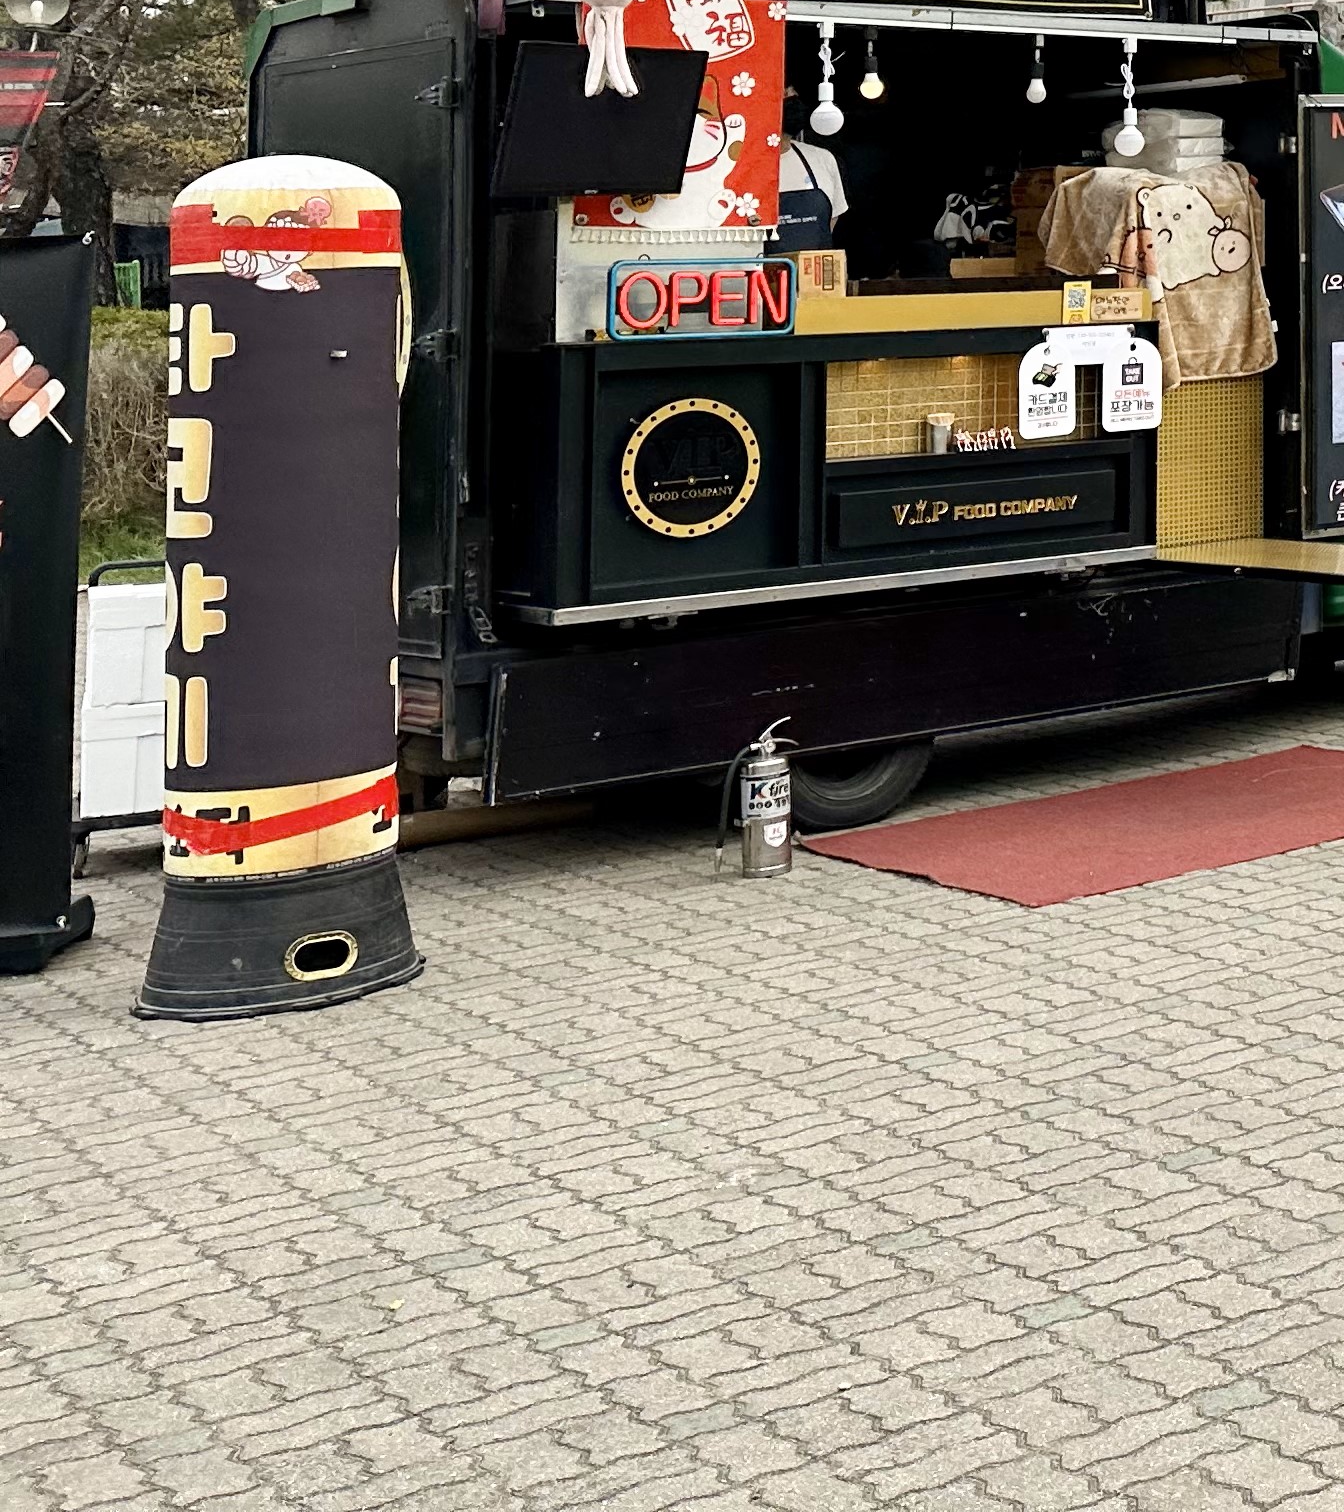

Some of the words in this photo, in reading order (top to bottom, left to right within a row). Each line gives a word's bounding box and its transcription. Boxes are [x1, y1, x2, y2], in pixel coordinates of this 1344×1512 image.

[618, 269, 788, 330] OPEN
[648, 490, 679, 503] FOOD
[681, 485, 734, 501] COMPANY
[953, 504, 997, 522] FOOD
[1000, 495, 1078, 518] COMPANY
